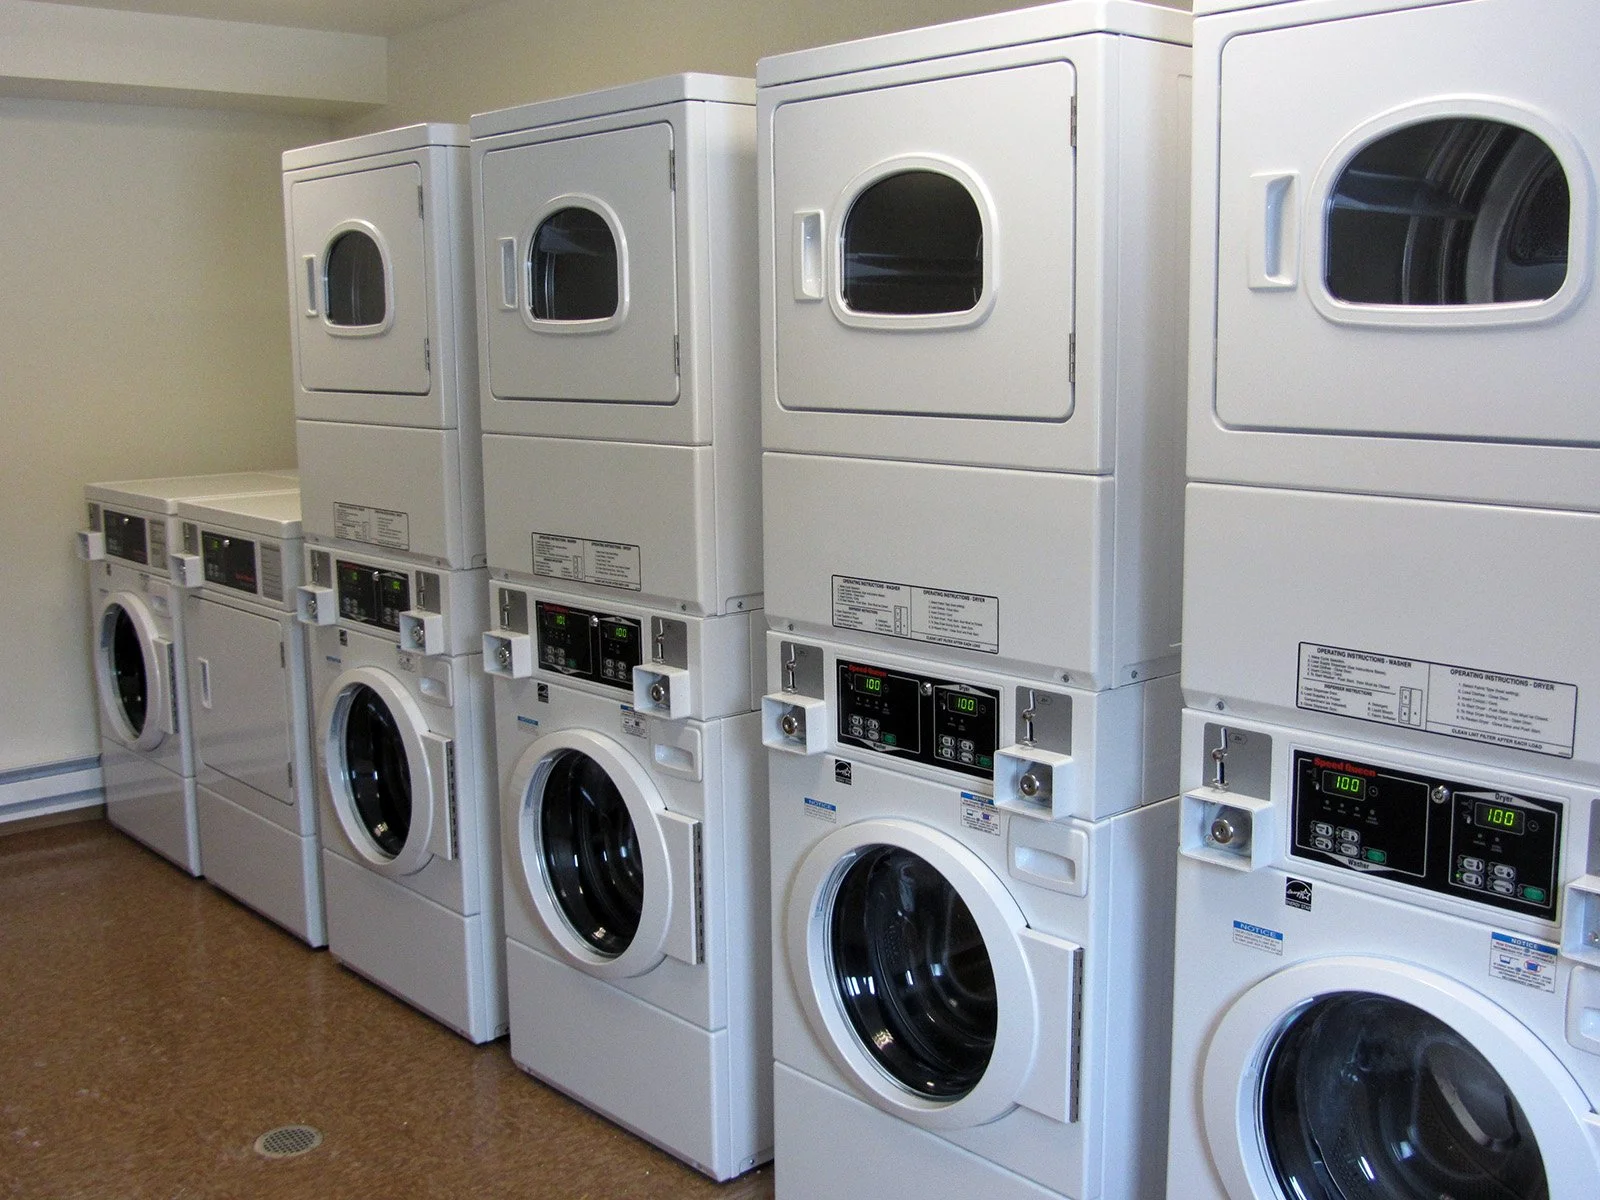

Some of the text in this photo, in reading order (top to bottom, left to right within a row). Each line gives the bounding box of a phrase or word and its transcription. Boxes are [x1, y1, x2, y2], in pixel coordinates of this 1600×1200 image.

[1317, 647, 1345, 657] OPERATING
[1347, 652, 1384, 663] INSTRUCTIONS
[1389, 659, 1411, 667] WASHER
[866, 678, 880, 691] 100
[1450, 668, 1483, 679] OPERATING
[1484, 674, 1528, 686] INSTRUCTIONS
[1533, 682, 1554, 690] DRYER
[1346, 688, 1372, 696] INSTRUCTIONS
[957, 697, 974, 711] 100
[1479, 733, 1496, 741] FILTER
[1313, 757, 1345, 771] Speed
[1336, 775, 1360, 793] 100
[1495, 792, 1513, 804] Dryer
[1488, 808, 1515, 826] 100
[1348, 858, 1370, 869] Washer
[1240, 923, 1277, 938] NOTICE
[1511, 938, 1539, 949] NOTICE
